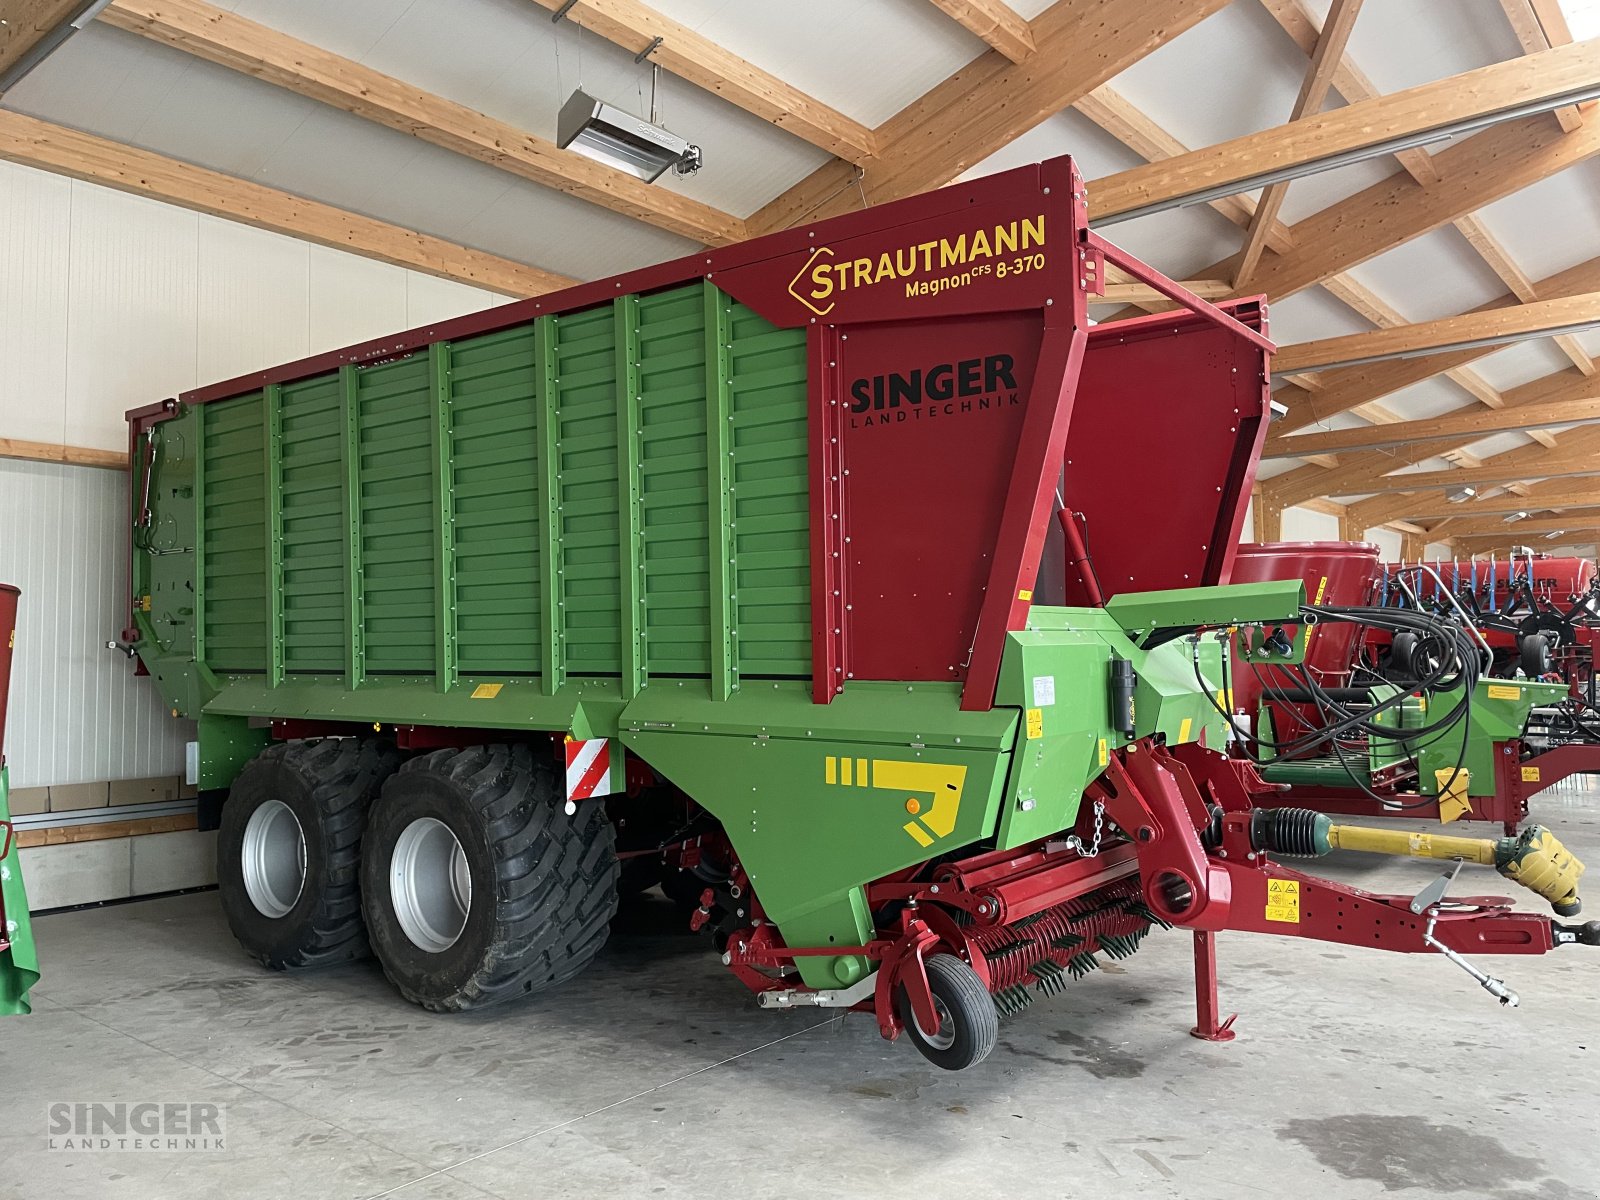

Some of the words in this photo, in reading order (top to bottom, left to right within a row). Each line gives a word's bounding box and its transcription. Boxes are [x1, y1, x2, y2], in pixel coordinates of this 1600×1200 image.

[810, 214, 1046, 299] STRAUTMANN
[996, 253, 1046, 279] 8-370
[851, 354, 1018, 413] SINGER
[851, 393, 1019, 429] LANDTECHNIK
